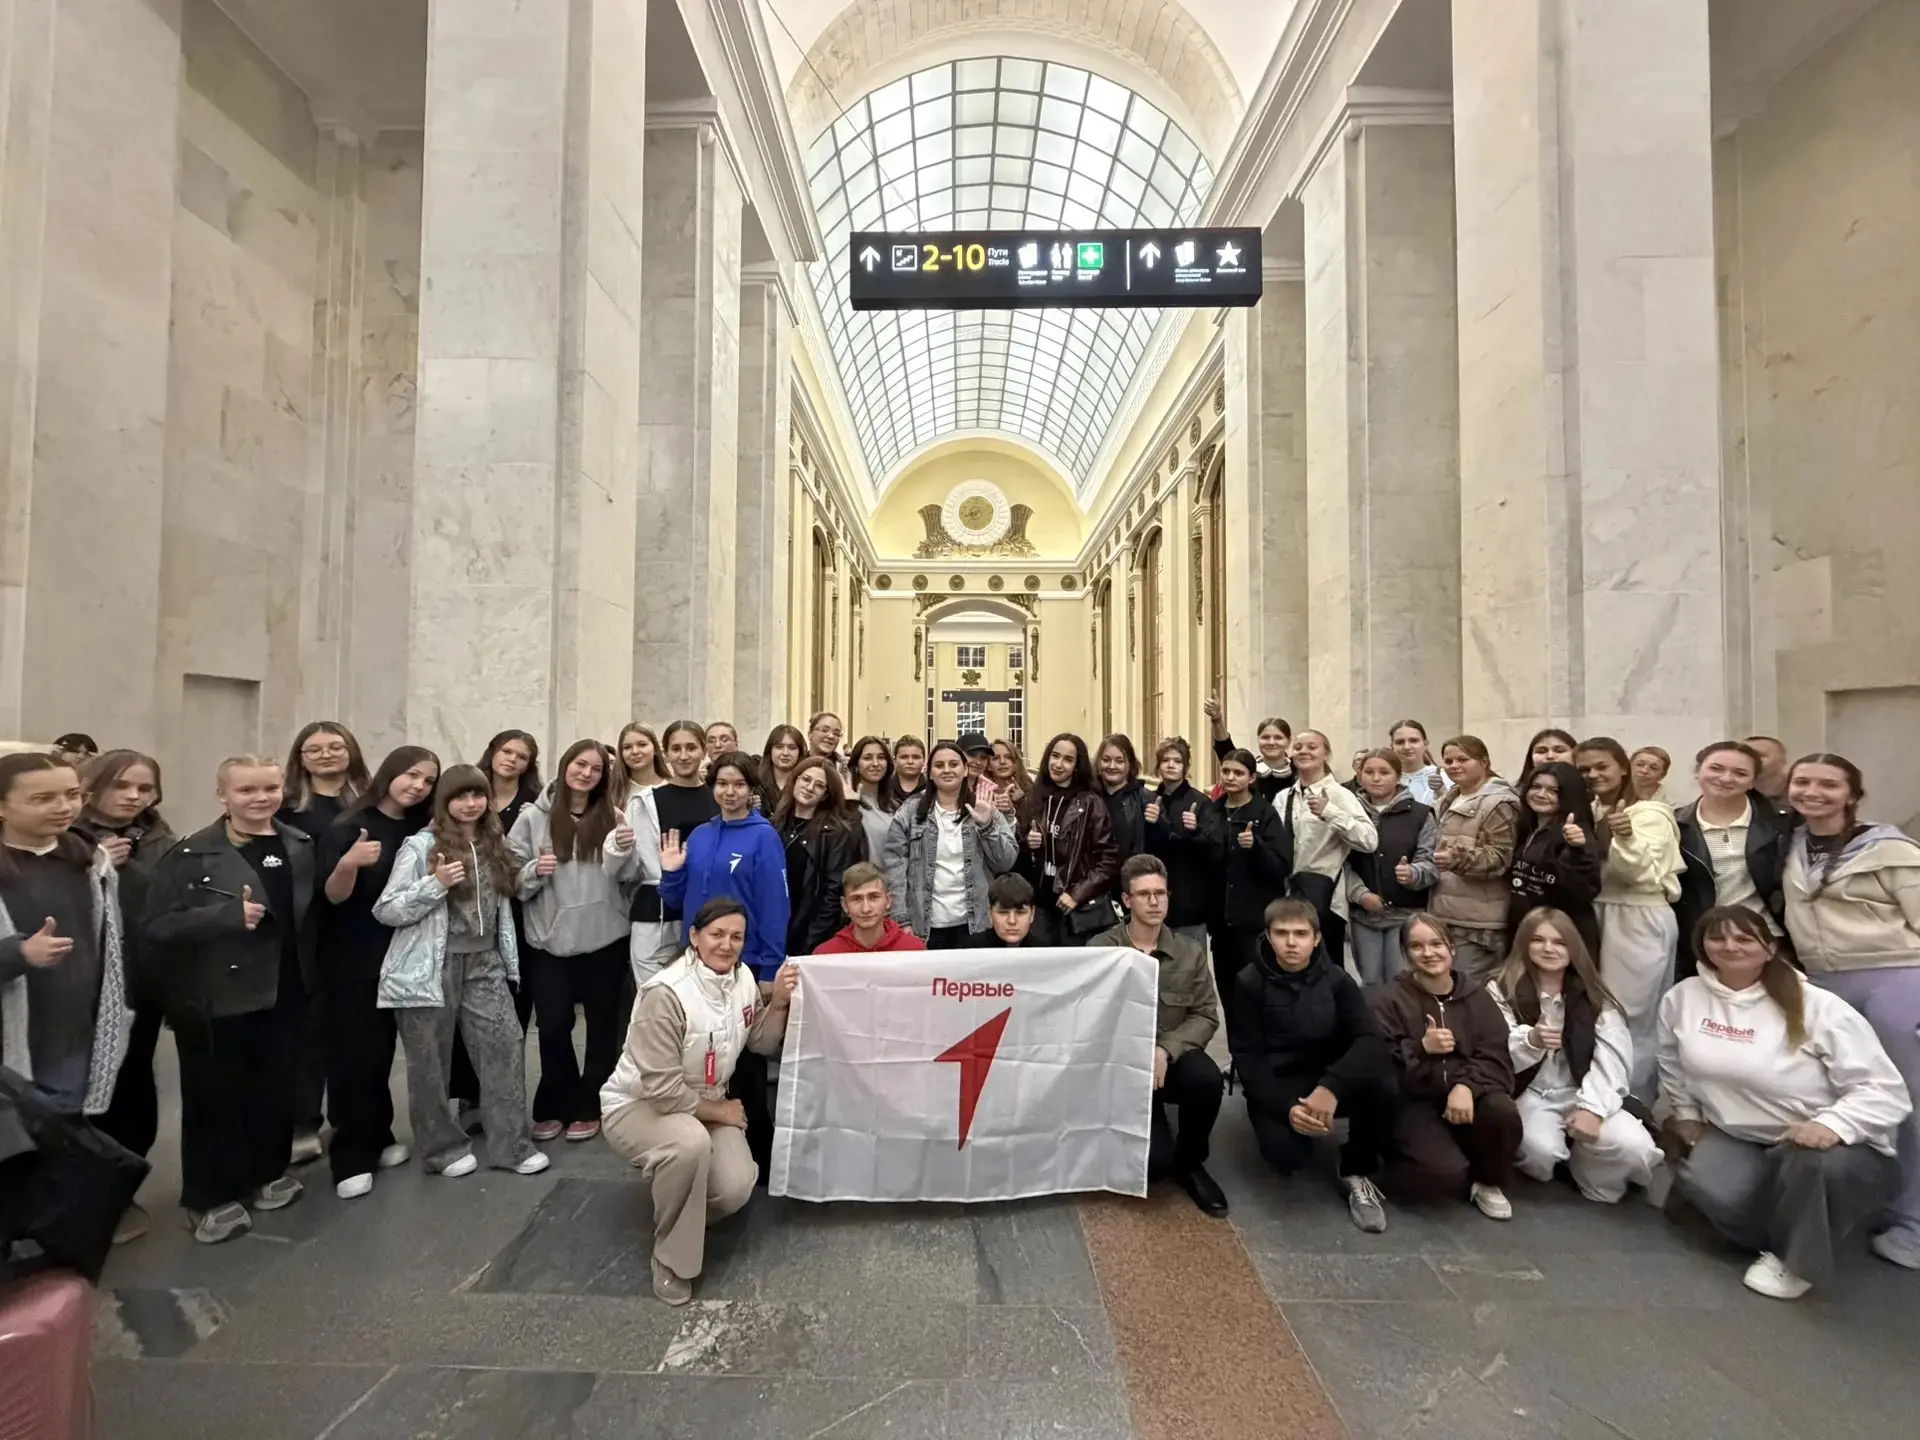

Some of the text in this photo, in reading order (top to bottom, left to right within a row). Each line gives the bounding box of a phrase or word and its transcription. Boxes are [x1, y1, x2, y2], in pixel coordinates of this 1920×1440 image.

[922, 243, 986, 271] 2-10
[988, 247, 1009, 258] Пути
[932, 977, 1015, 1003] Первые
[1701, 1017, 1756, 1037] Первые
